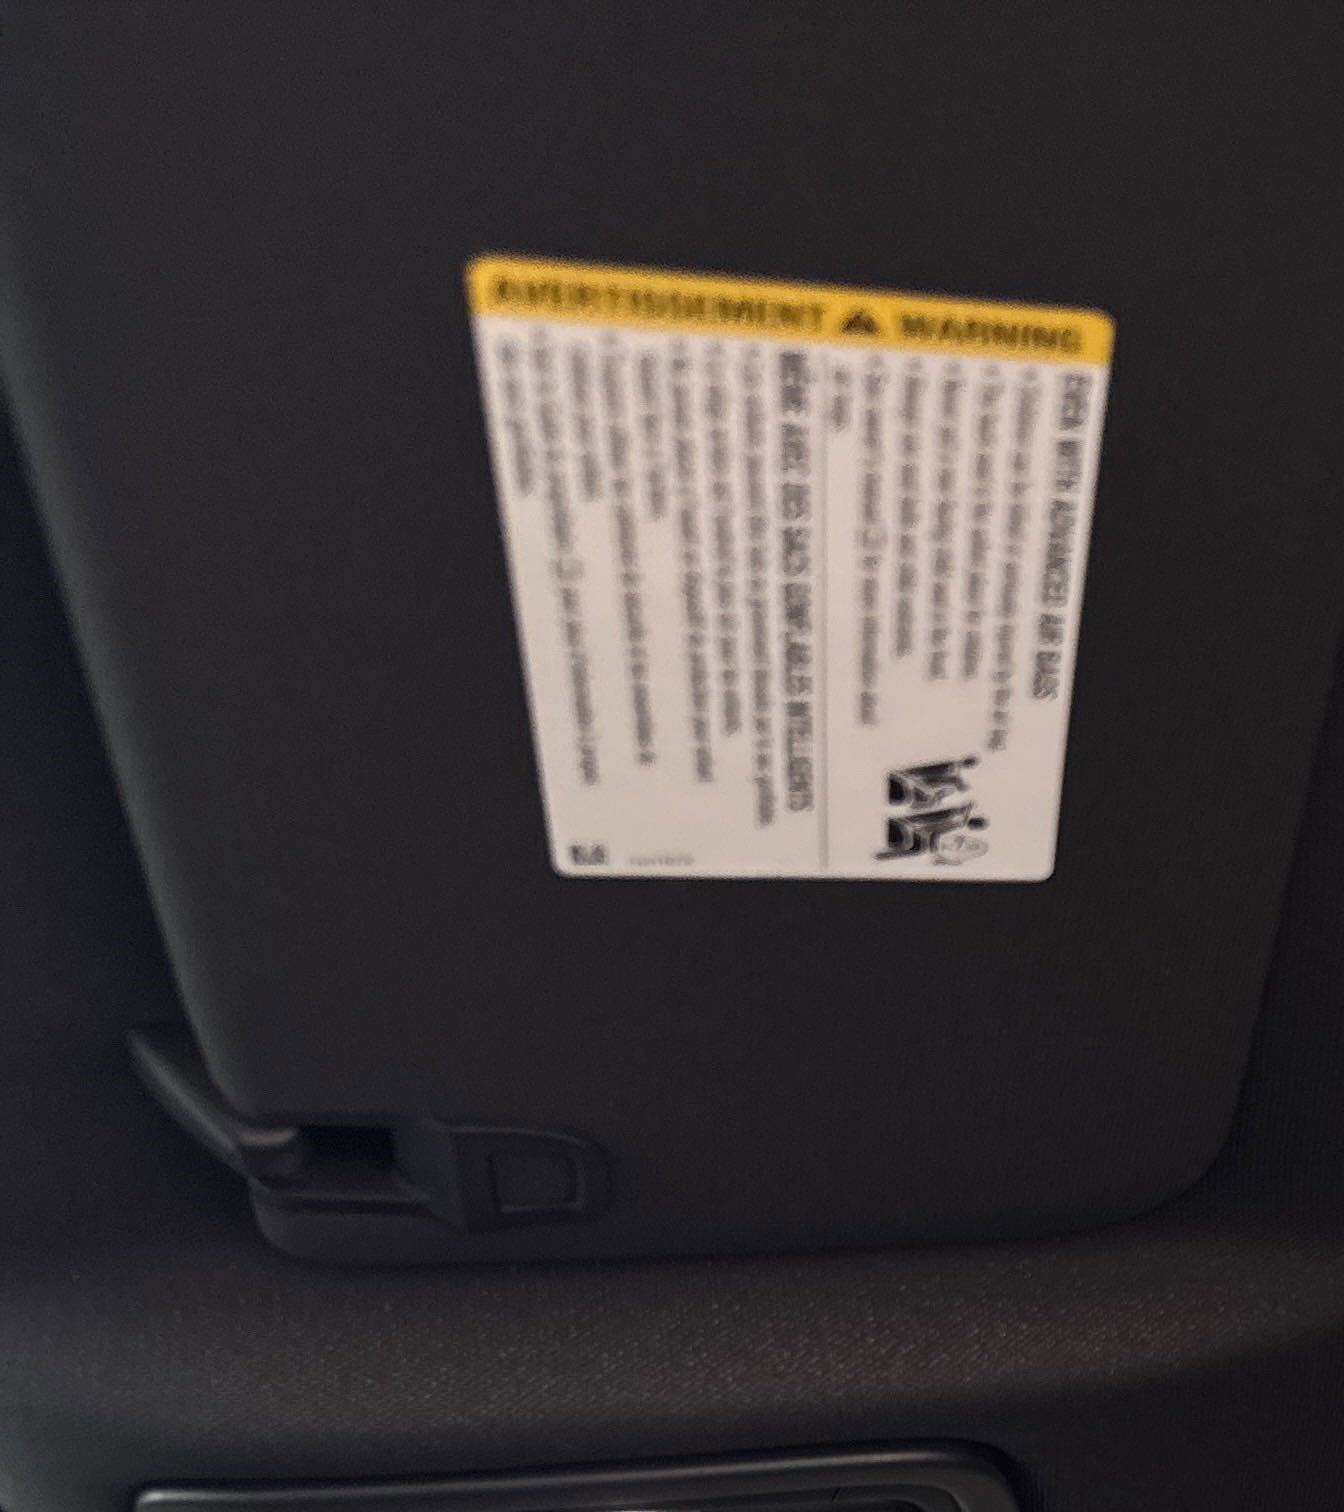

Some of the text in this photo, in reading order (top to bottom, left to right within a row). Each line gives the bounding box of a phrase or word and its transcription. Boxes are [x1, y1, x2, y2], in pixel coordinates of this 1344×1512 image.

[496, 277, 823, 335] AVERTISSEMENT
[901, 312, 1083, 355] WARNING
[1032, 372, 1093, 700] EVEN WITH ADVANCED AIR BAGS
